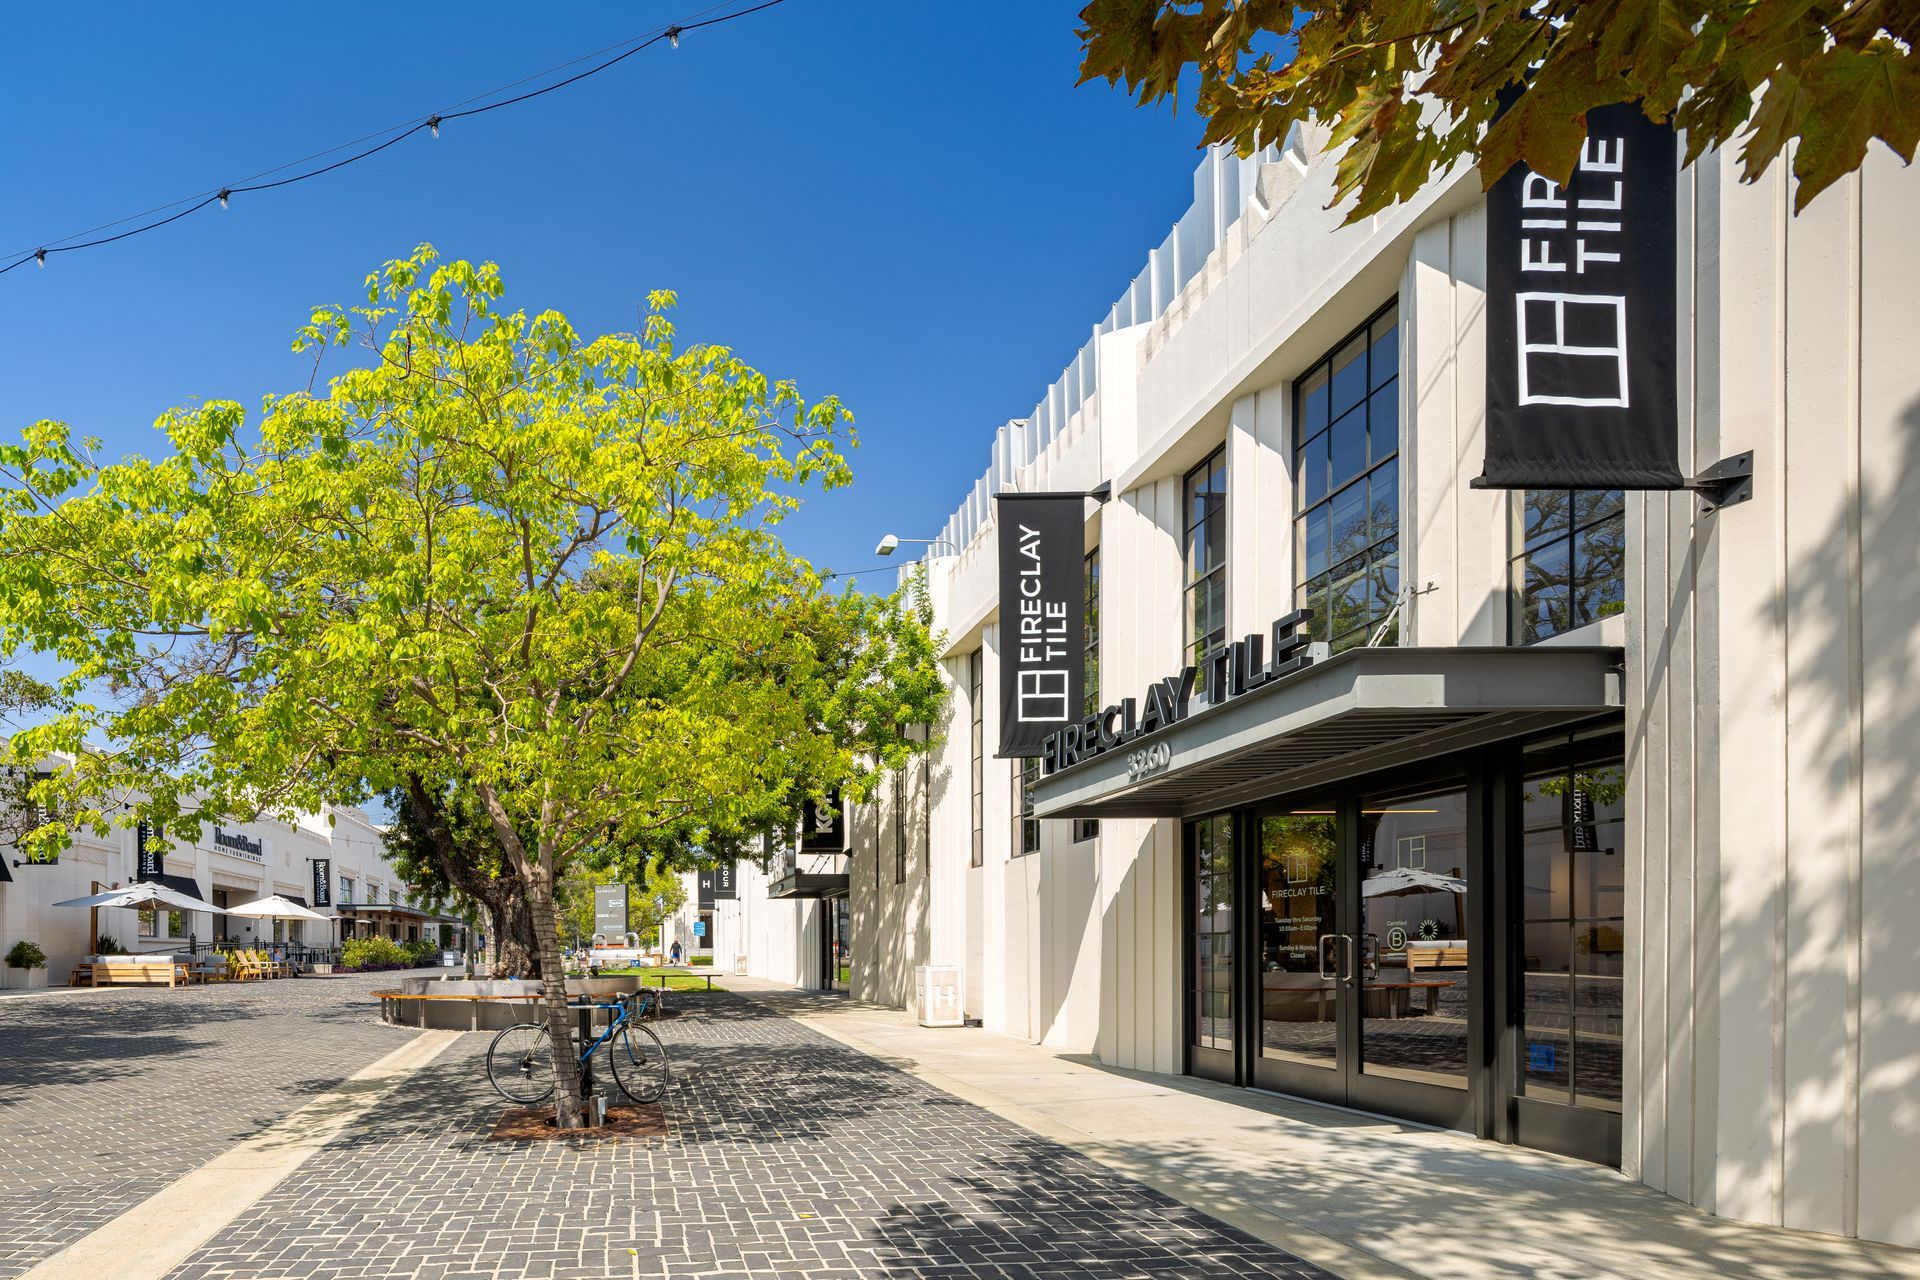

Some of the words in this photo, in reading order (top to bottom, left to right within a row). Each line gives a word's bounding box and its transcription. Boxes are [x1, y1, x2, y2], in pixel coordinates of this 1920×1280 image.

[1577, 137, 1624, 274] TILE
[1018, 523, 1041, 663] FIRECLAY
[1045, 601, 1067, 662] TILE
[1042, 666, 1198, 775] FIRECLAY
[1200, 608, 1314, 705] TILE
[1127, 741, 1170, 777] 3260
[214, 826, 262, 856] Room&Board
[703, 880, 711, 889] H
[1271, 888, 1307, 899] FIRECLAY
[1308, 886, 1326, 896] TILE
[1392, 931, 1402, 947] B
